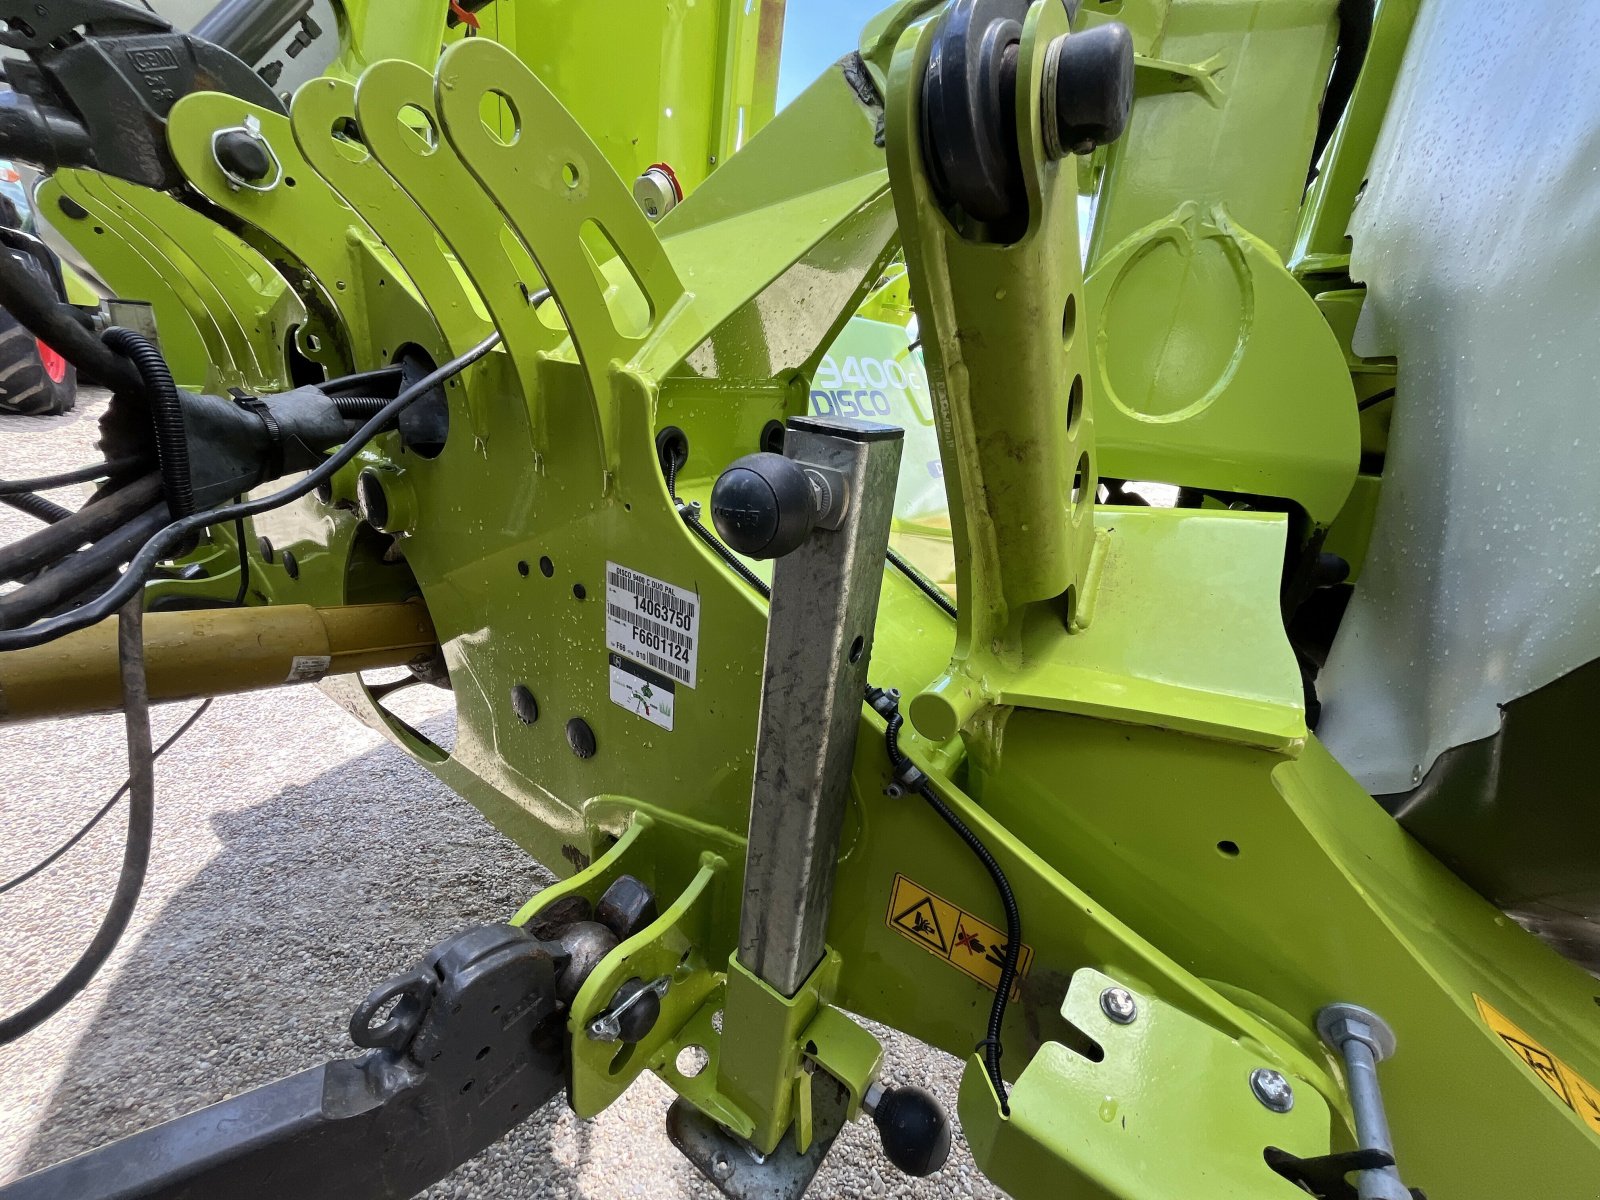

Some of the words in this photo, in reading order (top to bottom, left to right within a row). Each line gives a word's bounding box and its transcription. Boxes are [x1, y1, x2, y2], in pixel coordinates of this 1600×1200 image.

[816, 355, 907, 390] 9400
[810, 390, 891, 417] DISCO
[616, 567, 632, 579] DISCO
[633, 573, 645, 584] 9400
[651, 581, 663, 591] DUO
[664, 585, 676, 597] PAL
[633, 595, 691, 631] 14063750
[632, 626, 689, 664] F6601124
